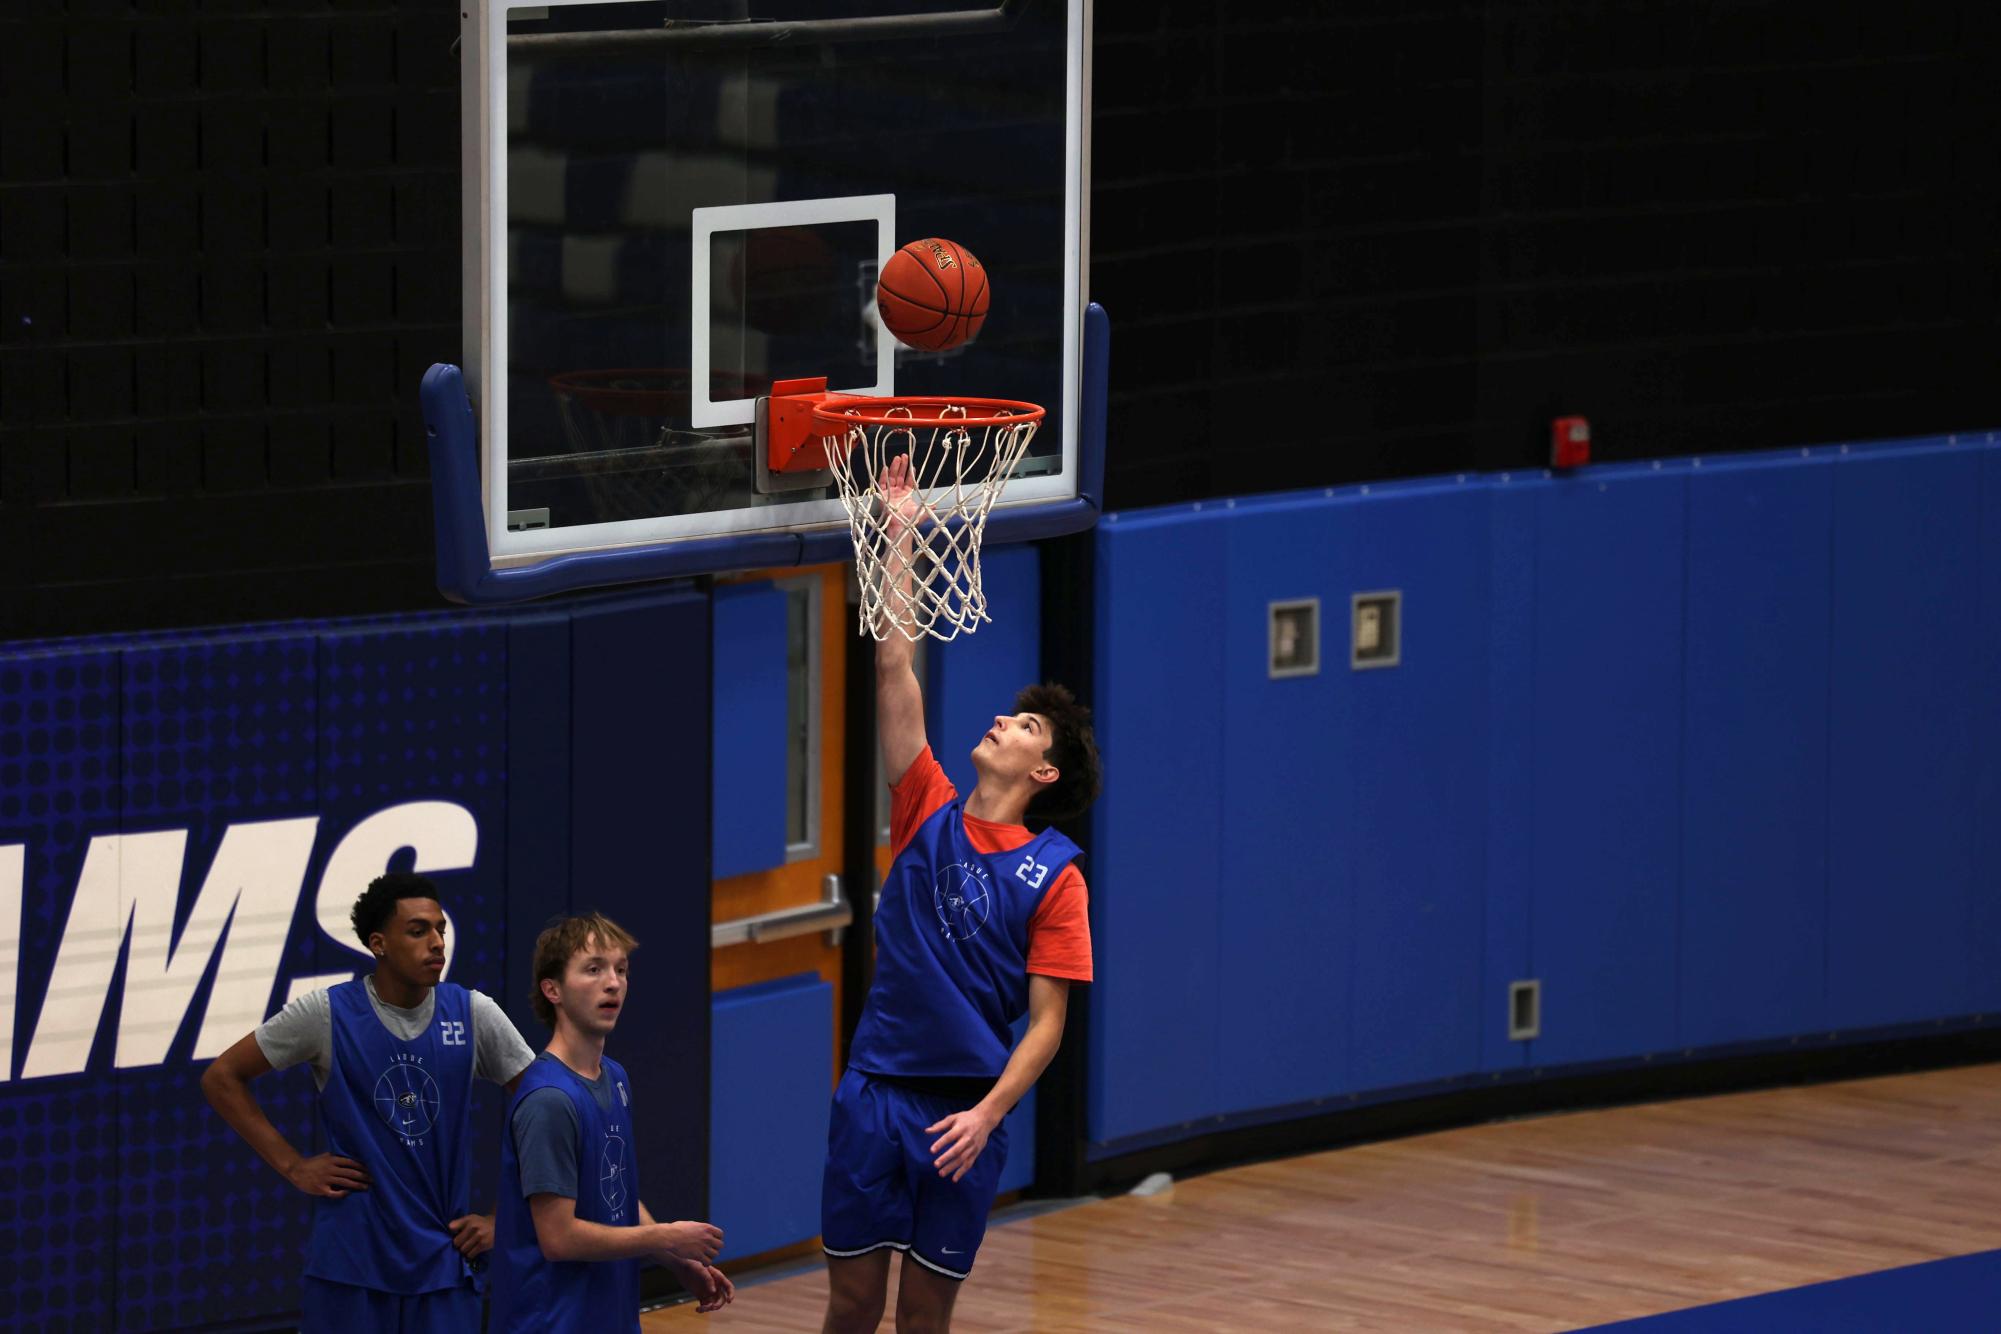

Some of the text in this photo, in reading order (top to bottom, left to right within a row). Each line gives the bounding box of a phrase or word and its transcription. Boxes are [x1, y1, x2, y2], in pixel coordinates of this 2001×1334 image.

[1015, 855, 1049, 889] 23
[0, 800, 478, 1082] MS
[440, 1021, 466, 1046] 22
